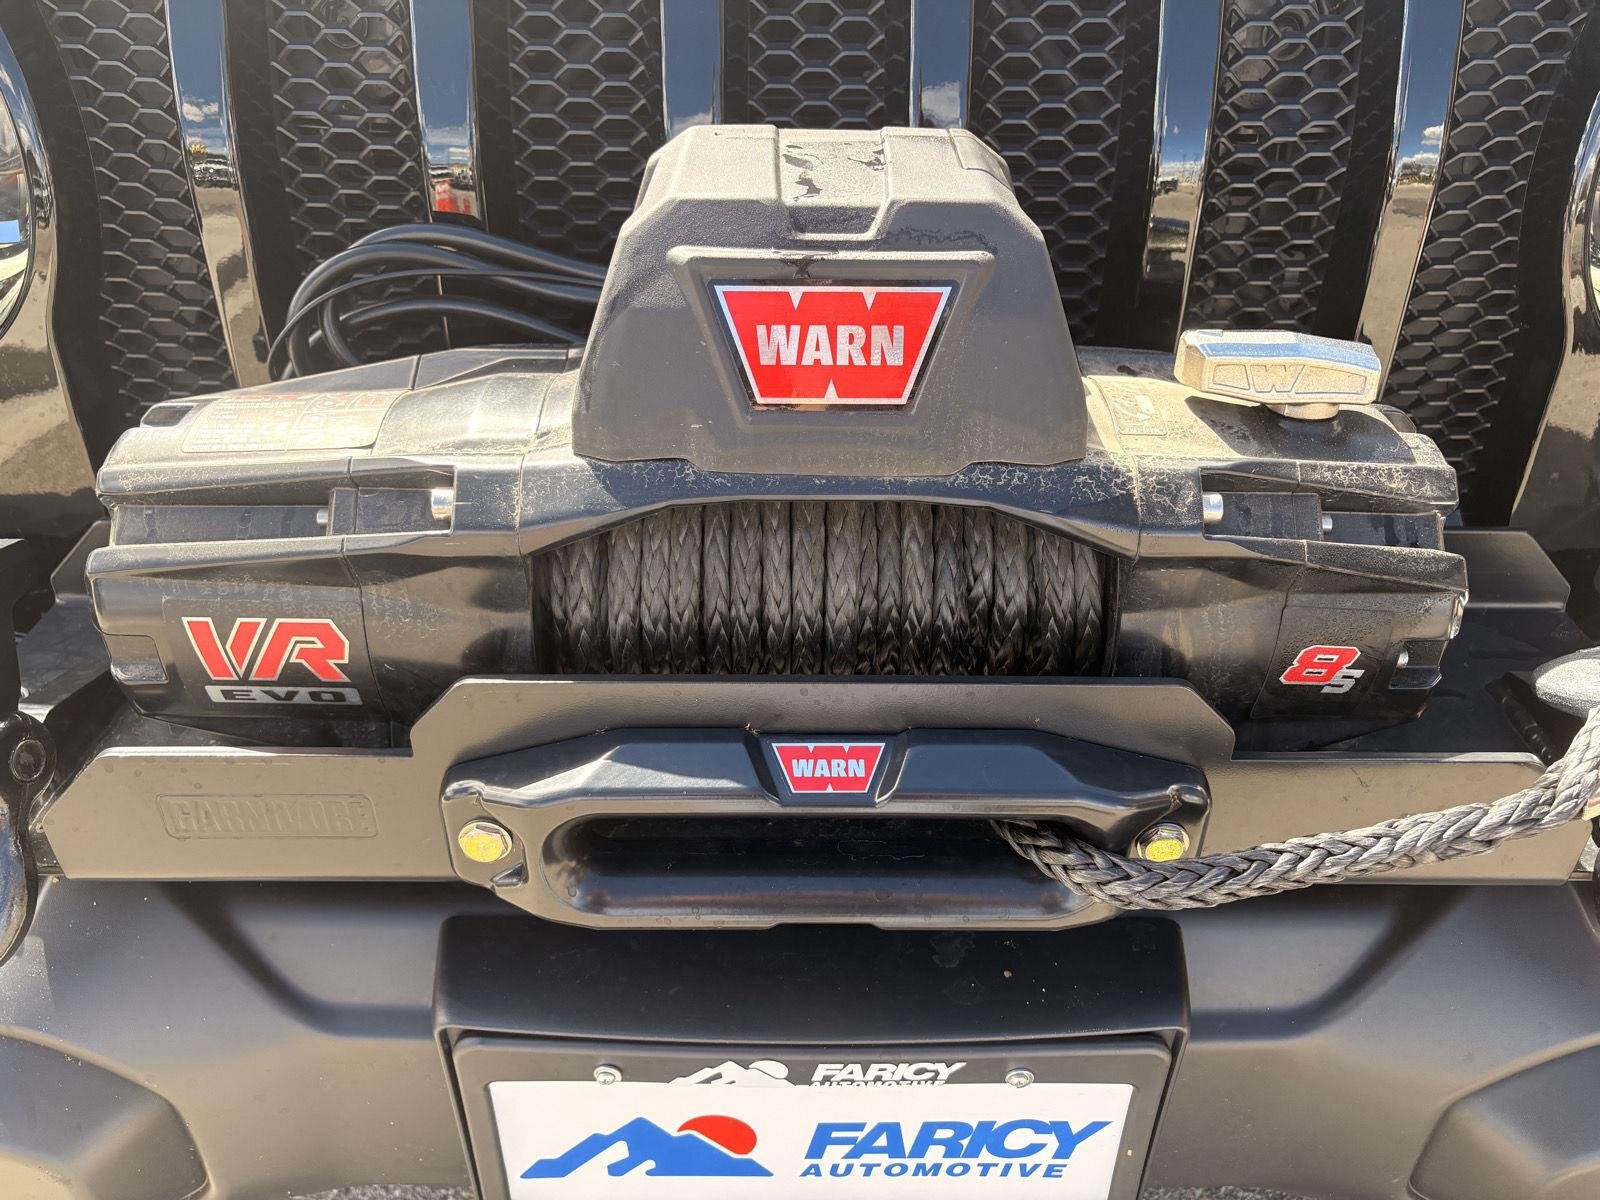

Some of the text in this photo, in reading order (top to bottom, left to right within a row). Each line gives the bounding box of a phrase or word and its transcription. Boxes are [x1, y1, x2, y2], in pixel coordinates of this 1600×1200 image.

[755, 324, 905, 366] WARN
[181, 616, 352, 682] VR
[219, 688, 344, 703] EVO
[791, 759, 866, 777] WARN
[811, 1062, 967, 1081] FARICY
[804, 1119, 1114, 1159] FARICY
[799, 1162, 1067, 1178] AUTOMOTIVE
